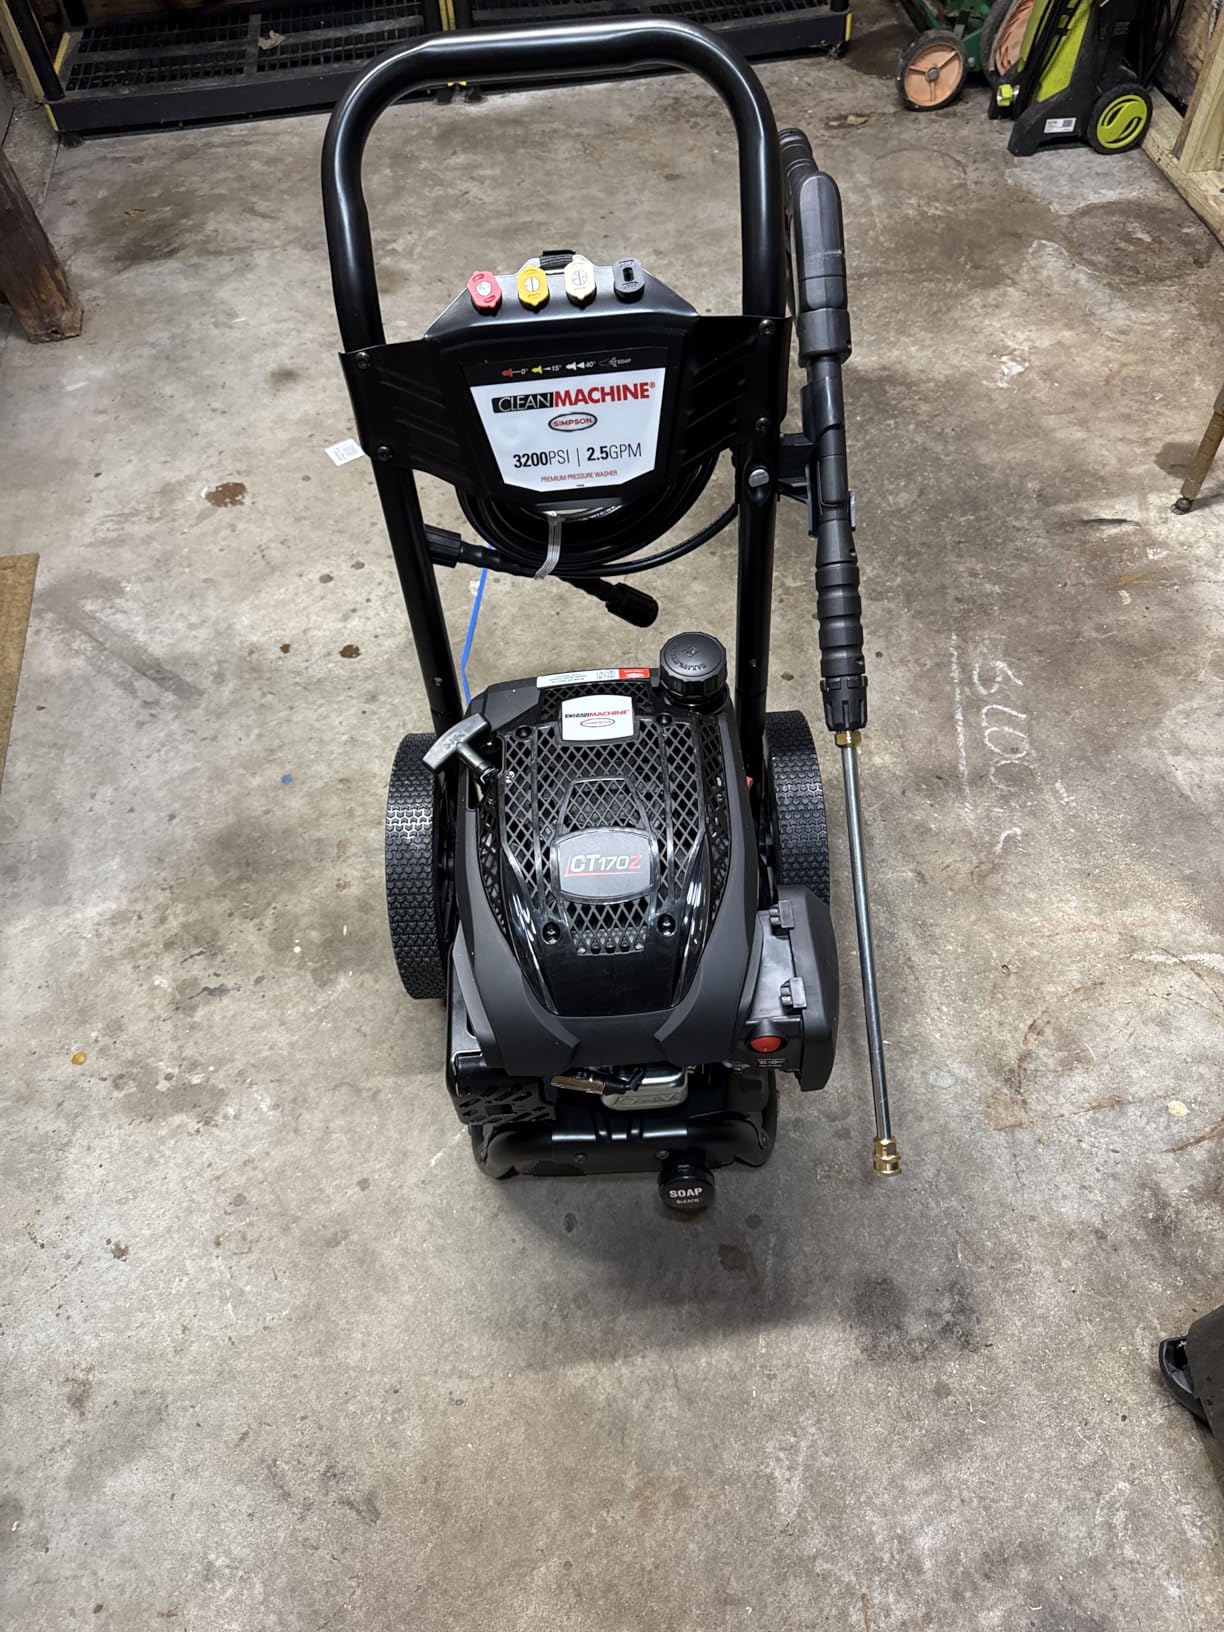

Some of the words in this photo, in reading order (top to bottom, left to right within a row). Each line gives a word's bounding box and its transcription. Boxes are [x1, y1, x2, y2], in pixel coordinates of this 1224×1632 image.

[553, 417, 593, 427] SIMPSON
[513, 449, 570, 469] 3200PSI
[586, 442, 642, 461] 2.5GPM
[541, 474, 567, 483] PREMIUM
[567, 471, 594, 481] PRESSURE
[595, 469, 618, 478] WASHER
[669, 1187, 703, 1198] SOAP
